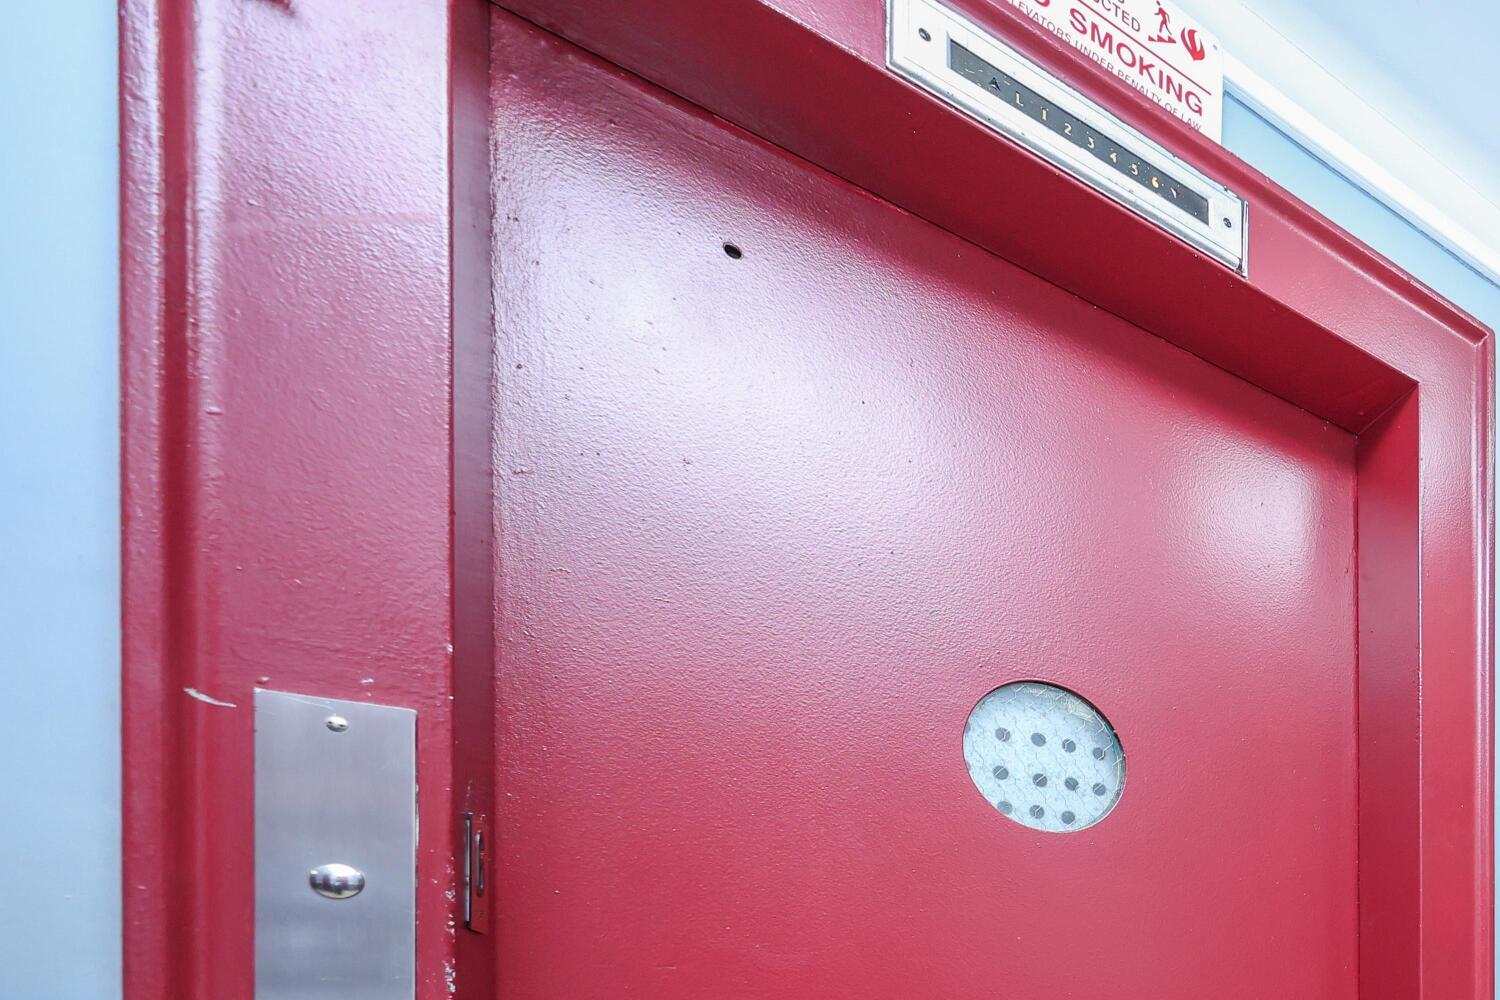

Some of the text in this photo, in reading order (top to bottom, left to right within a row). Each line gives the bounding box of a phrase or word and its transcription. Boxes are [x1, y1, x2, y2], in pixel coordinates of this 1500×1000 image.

[1094, 0, 1140, 32] CTED
[1070, 8, 1202, 117] SMOKING
[1075, 39, 1114, 74] UNDER
[1164, 102, 1179, 116] OF
[1015, 91, 1024, 107] L
[1064, 122, 1073, 136] 2
[1087, 136, 1096, 149] 3
[1109, 150, 1119, 164] 4
[1129, 163, 1139, 176] 5
[1151, 176, 1160, 188] 6
